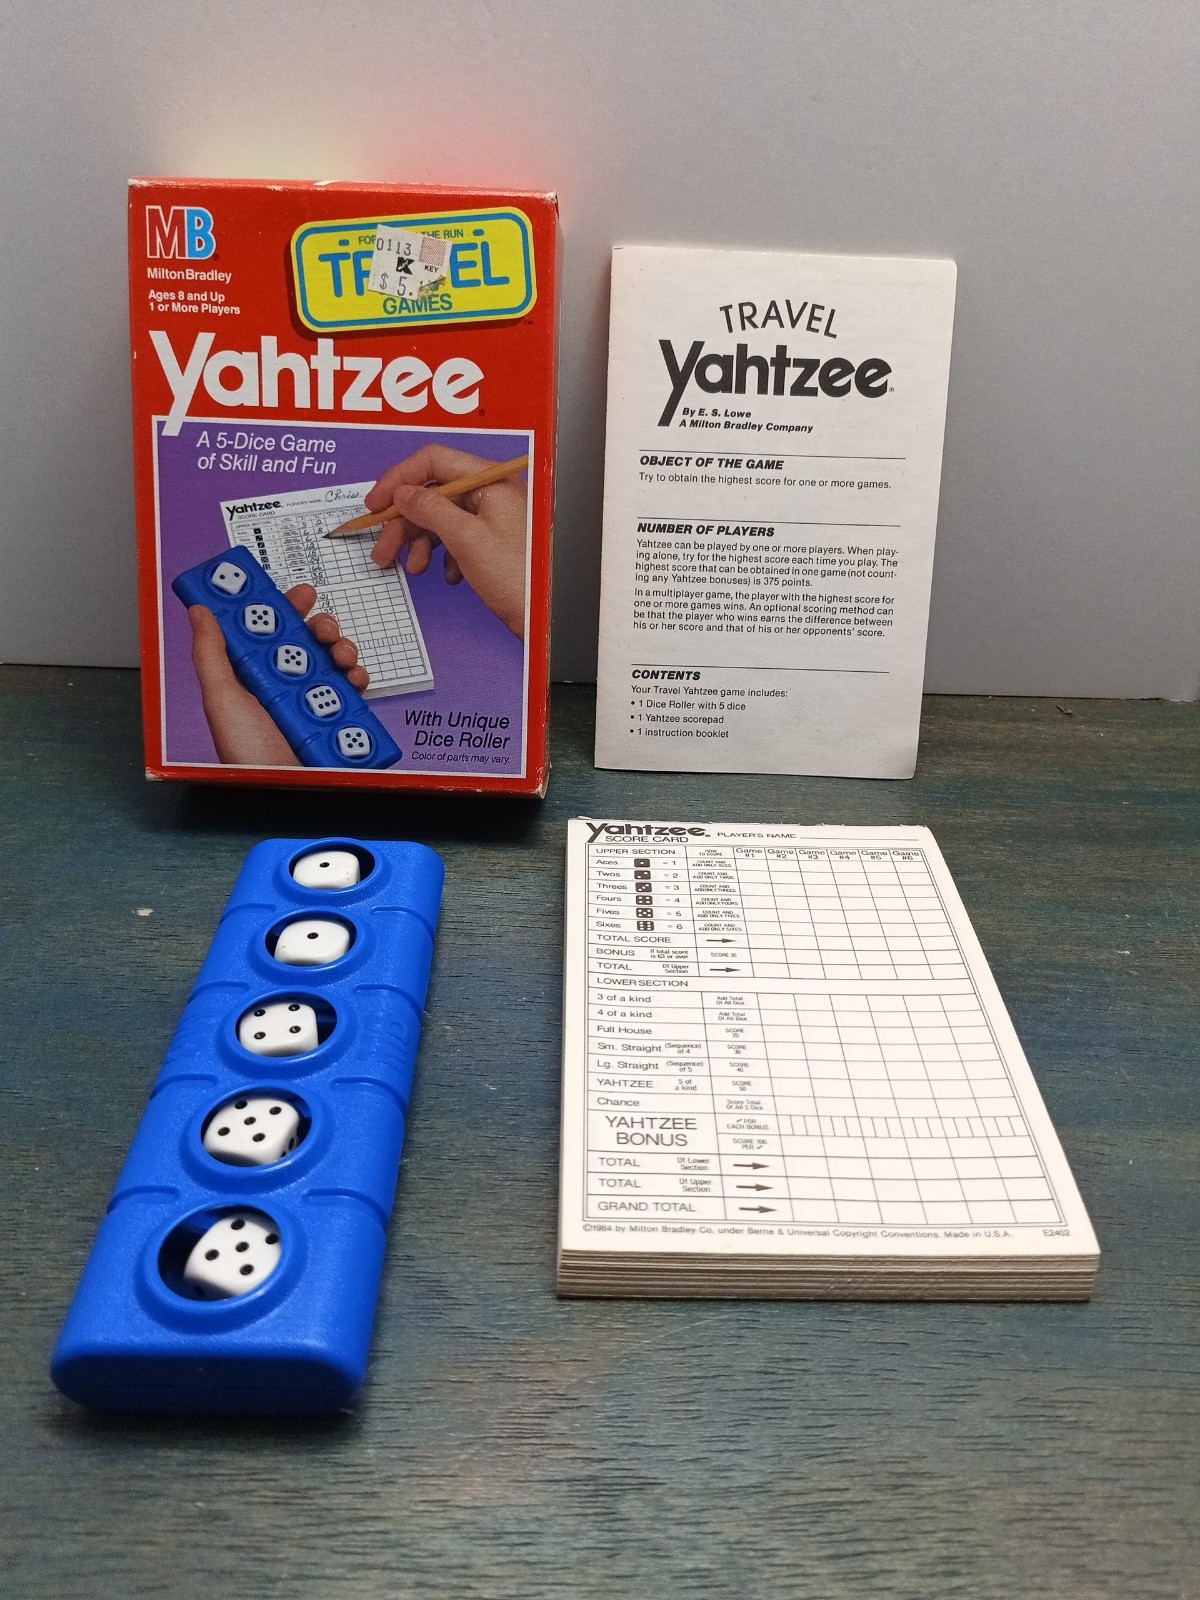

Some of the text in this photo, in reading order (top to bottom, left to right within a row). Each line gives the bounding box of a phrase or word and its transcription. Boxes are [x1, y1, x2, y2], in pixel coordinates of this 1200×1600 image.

[146, 206, 215, 260] MB
[444, 229, 464, 238] RUN
[376, 238, 411, 256] 0113
[424, 265, 438, 273] KEY
[148, 289, 225, 304] Ages 8 and Up
[149, 301, 240, 316] 1 or More Players
[383, 294, 452, 315] GAMES
[719, 299, 837, 339] TRAVEL
[682, 407, 751, 418] By E. S. Lowe
[678, 418, 813, 433] A Milton Bradley Company
[196, 430, 336, 452] A 5-Dice Game
[197, 452, 336, 474] of Skill and Fun
[639, 455, 784, 470] OBJECT OF THE GAME
[638, 471, 653, 482] Try
[656, 473, 665, 481] to
[668, 473, 697, 482] obtain
[700, 474, 715, 483] the
[718, 474, 752, 485] highest
[755, 477, 780, 485] score
[783, 476, 796, 486] for
[857, 481, 891, 490] games.
[637, 522, 774, 537] NUMBER OF PLAYERS
[636, 538, 672, 548] Yahtzee
[693, 540, 704, 549] be
[706, 541, 737, 552] played
[739, 542, 750, 553] by
[783, 545, 806, 553] more
[808, 545, 844, 555] players.
[847, 545, 873, 555] When
[876, 547, 898, 557] play-
[631, 669, 700, 680] CONTENTS
[630, 684, 787, 697] Your Travel Yahtzee game includes:
[638, 699, 745, 710] 1 Dice Roller with 5 dice
[405, 709, 509, 732] With Unique
[638, 713, 724, 725] 1 Yahtzee scorepad
[637, 727, 728, 738] 1 instruction booklet
[414, 730, 510, 749] Dice Roller
[411, 750, 509, 765] Color of parts may vary.
[596, 907, 619, 915] Fives
[595, 920, 621, 928] Sixes
[596, 933, 671, 943] TOTAL SCORE
[596, 947, 635, 956] BONUS
[596, 961, 632, 970] TOTAL
[596, 977, 636, 986] LOWER
[597, 1024, 652, 1034] Full House
[597, 1042, 661, 1053] Sm. Straight
[597, 1059, 658, 1071] Lg. Straight
[597, 1078, 653, 1088] YAHTZEE
[596, 1096, 639, 1106] Chance
[605, 1115, 697, 1130] YAHTZEE
[616, 1131, 687, 1146] BONUS
[598, 1156, 640, 1167] TOTAL
[598, 1178, 641, 1188] TOTAL
[597, 1201, 696, 1212] GRAND TOTAL
[661, 1225, 696, 1234] Bradley
[747, 1227, 774, 1235] Berne
[787, 1228, 829, 1236] Universal
[832, 1228, 877, 1238] Copyright
[880, 1230, 940, 1238] Conventions.
[1042, 1228, 1070, 1236] E2402
